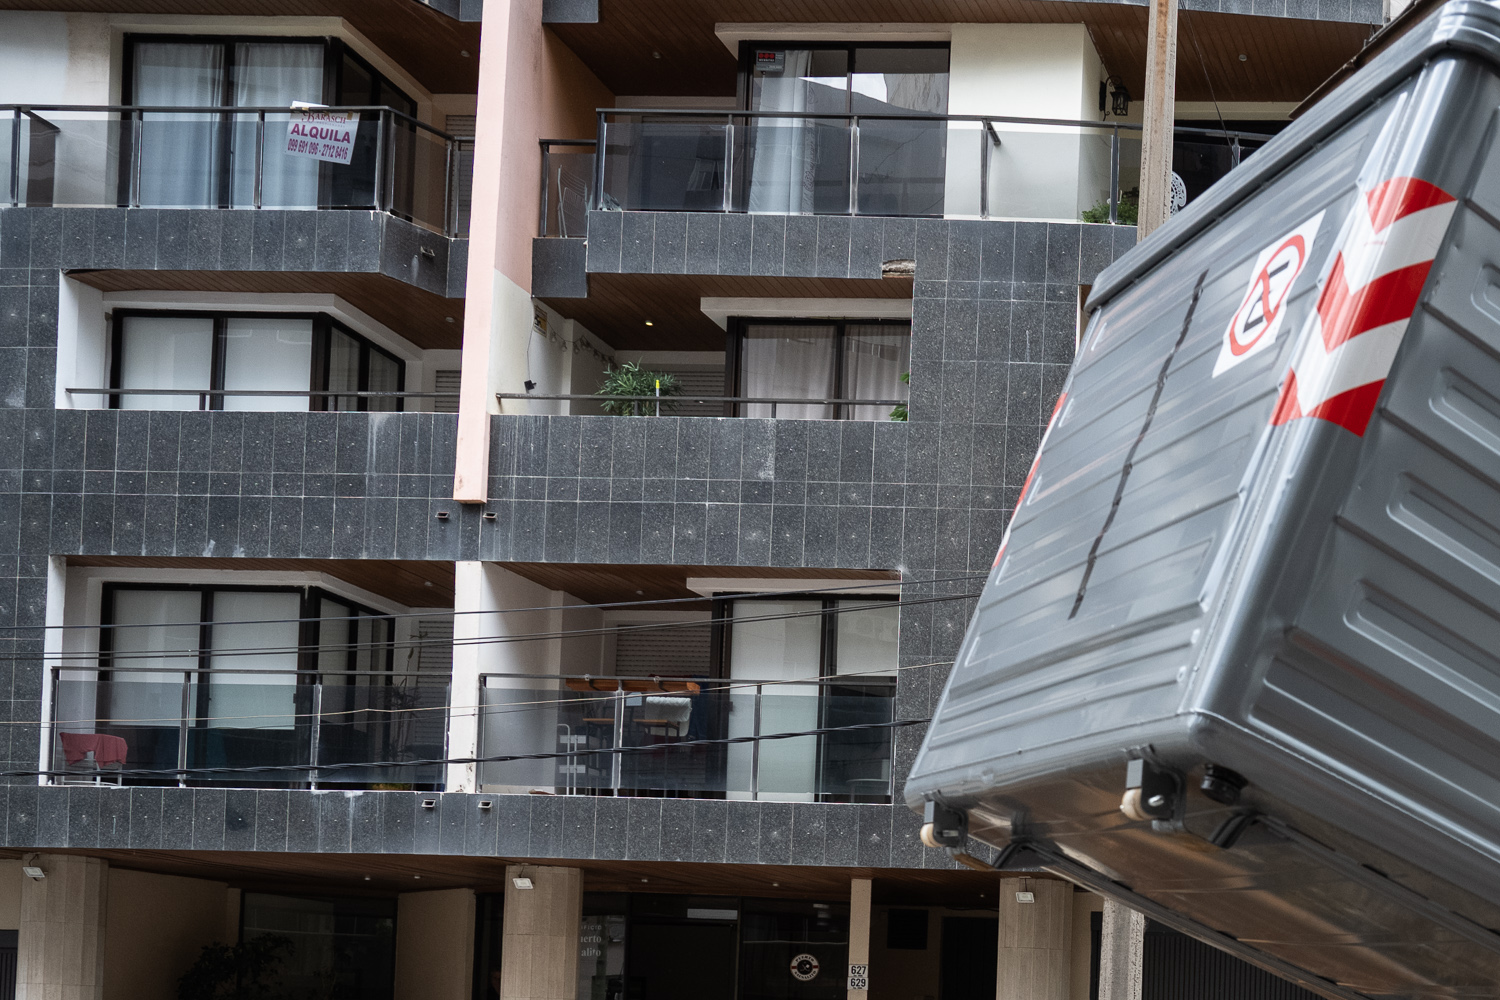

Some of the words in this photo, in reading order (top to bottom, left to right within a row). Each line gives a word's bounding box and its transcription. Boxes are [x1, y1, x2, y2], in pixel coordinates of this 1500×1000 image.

[290, 123, 350, 144] ALQUILA
[851, 965, 867, 975] 627
[850, 978, 866, 987] 629
